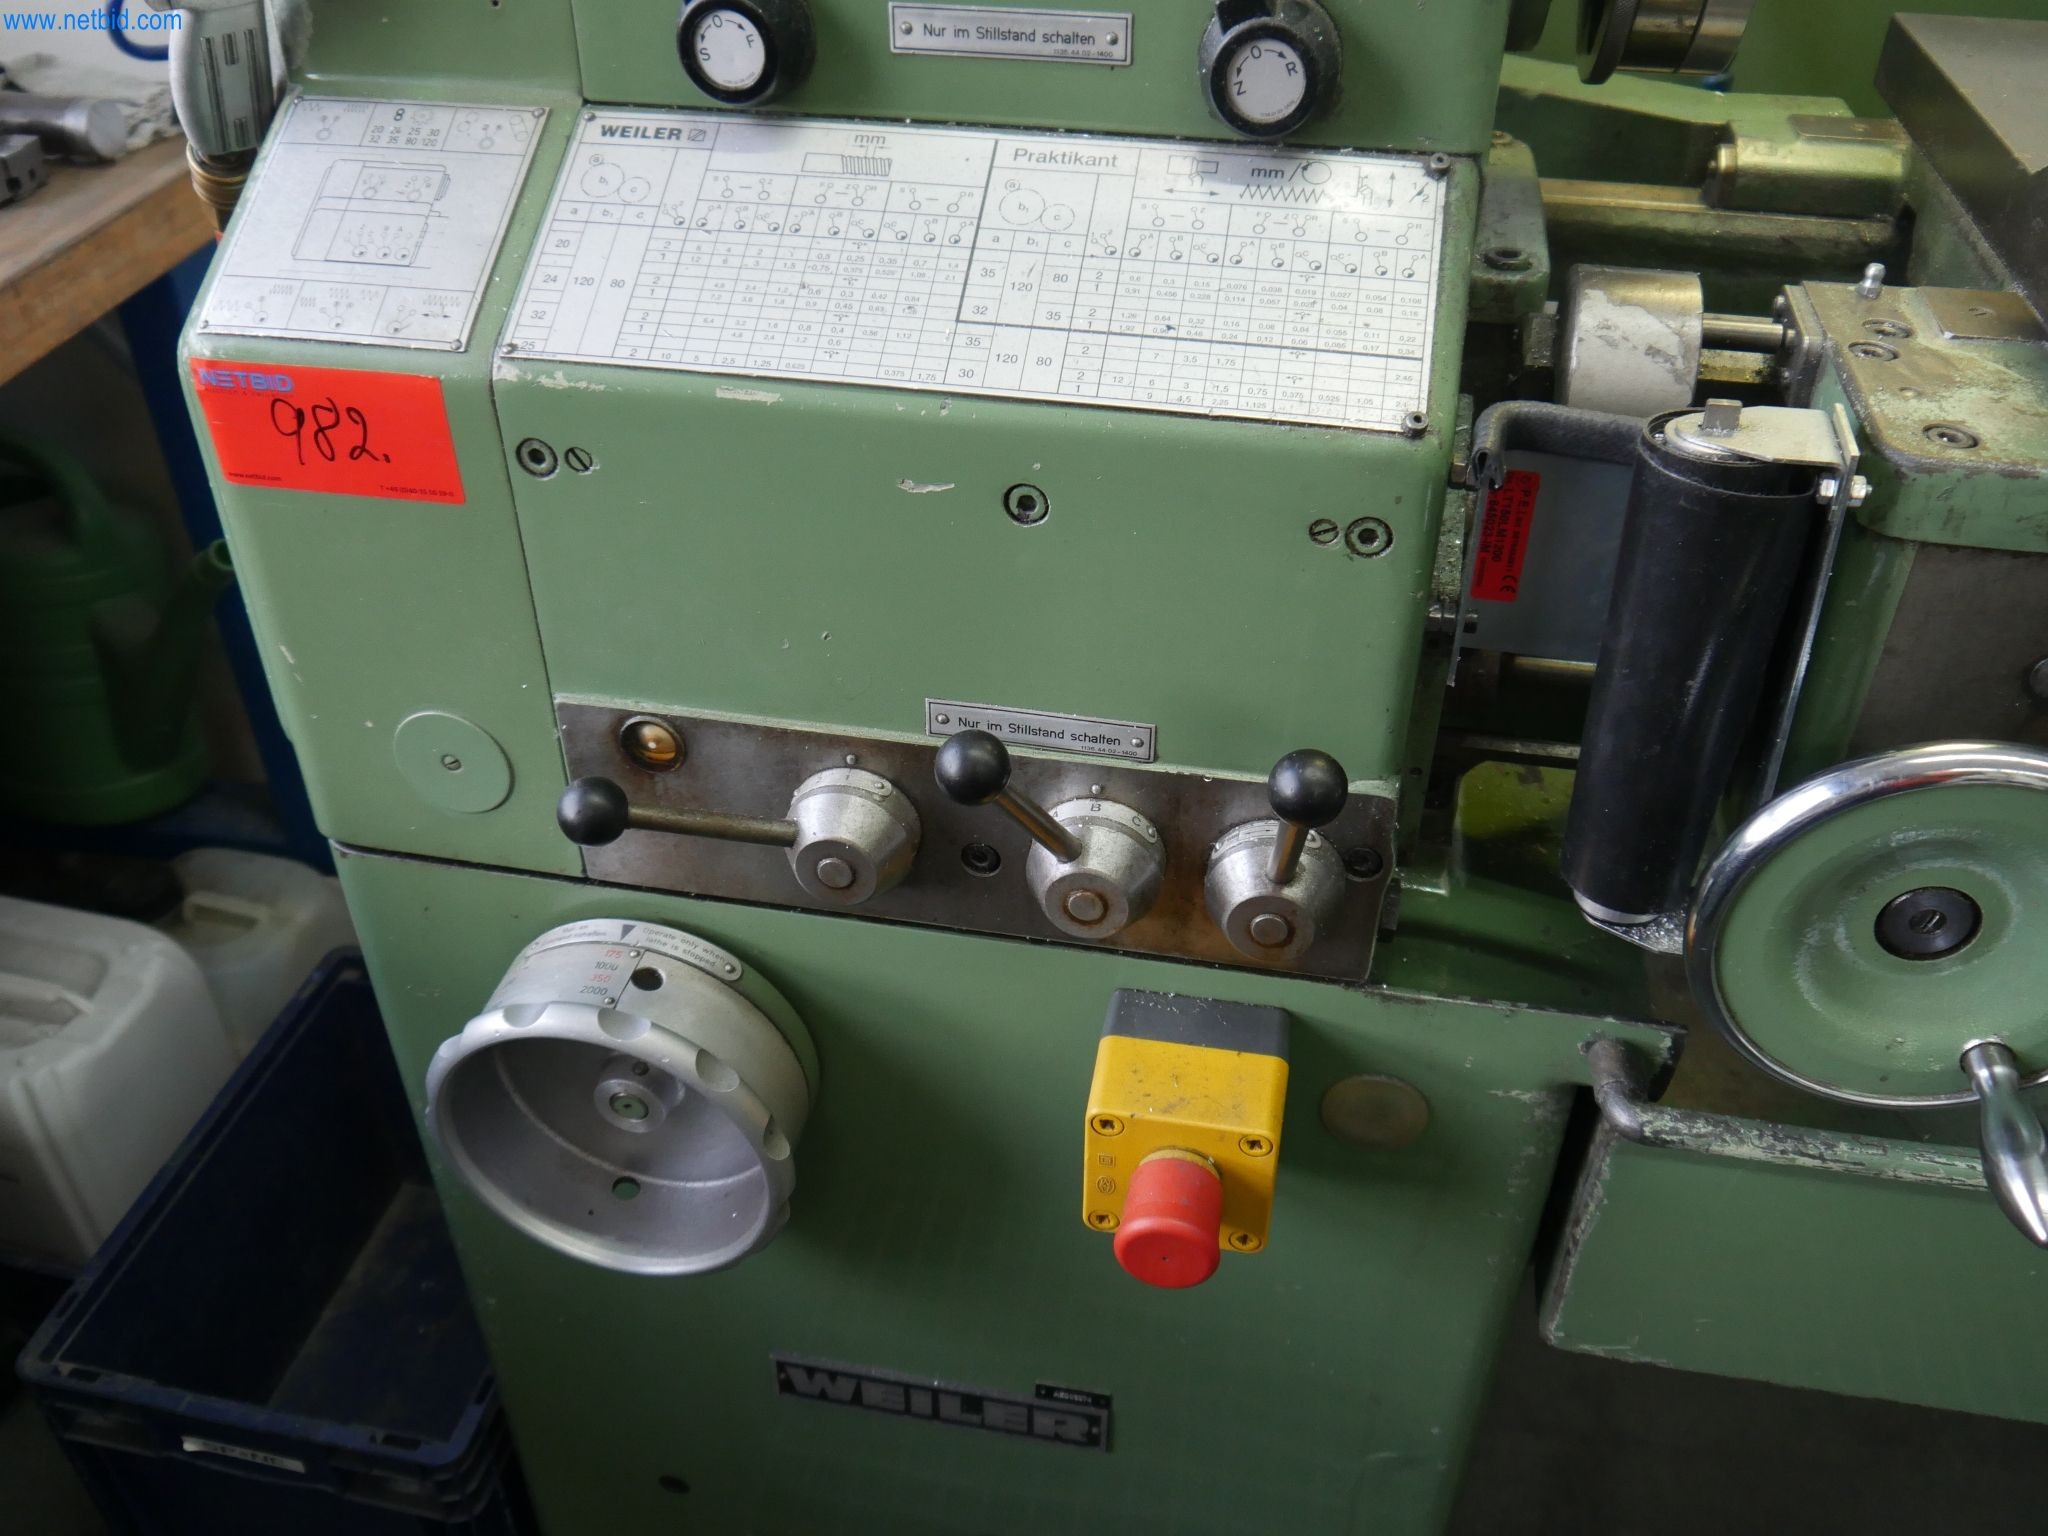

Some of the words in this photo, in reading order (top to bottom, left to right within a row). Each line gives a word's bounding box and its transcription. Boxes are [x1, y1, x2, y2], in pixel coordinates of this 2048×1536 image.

[746, 34, 754, 48] F
[924, 24, 946, 37] Nur
[954, 26, 970, 38] im
[977, 26, 1036, 42] Stillstand
[1043, 30, 1095, 46] schalten
[700, 48, 711, 61] S
[1286, 62, 1298, 76] R
[1234, 81, 1246, 96] Z
[394, 108, 405, 121] 8
[371, 125, 383, 133] 20
[408, 127, 421, 135] 25
[428, 128, 440, 137] 30
[601, 125, 682, 140] WEILER
[369, 135, 381, 143] 32
[387, 136, 399, 144] 35
[405, 137, 417, 145] 80
[422, 138, 438, 146] 120
[854, 135, 886, 144] mm
[1014, 148, 1118, 168] Praktikant
[1251, 166, 1284, 179] mm
[556, 239, 569, 248] 20
[664, 241, 671, 249] 2
[543, 274, 558, 283] 24
[573, 277, 594, 285] 120
[610, 279, 625, 288] 80
[981, 268, 995, 277] 35
[1010, 282, 1032, 291] 120
[1053, 274, 1068, 283] 80
[530, 311, 545, 319] 32
[641, 312, 648, 320] 2
[972, 306, 988, 315] 32
[1046, 311, 1061, 320] 35
[966, 337, 981, 346] 35
[996, 354, 1018, 363] 120
[1036, 357, 1052, 366] 80
[1216, 358, 1235, 366] 1,75
[520, 341, 535, 349] 25
[630, 349, 637, 357] 2
[918, 373, 936, 381] 1,75
[199, 367, 294, 392] NETBID
[958, 369, 974, 378] 30
[1077, 372, 1085, 380] 2
[1248, 388, 1267, 396] 0,75
[271, 397, 390, 467] 982.
[958, 717, 980, 728] Nur
[987, 720, 1002, 731] im
[1009, 724, 1064, 739] Stillstand
[1070, 732, 1121, 746] schalten
[1091, 803, 1101, 812] B
[1132, 816, 1141, 826] C
[642, 927, 677, 940] Operate
[681, 937, 699, 950] only
[703, 948, 725, 962] when
[646, 936, 669, 948] lathe
[683, 948, 716, 967] stopped
[605, 950, 623, 958] 175
[595, 961, 619, 971] 1000
[580, 986, 608, 995] 2000
[786, 1364, 1092, 1446] WEILER
